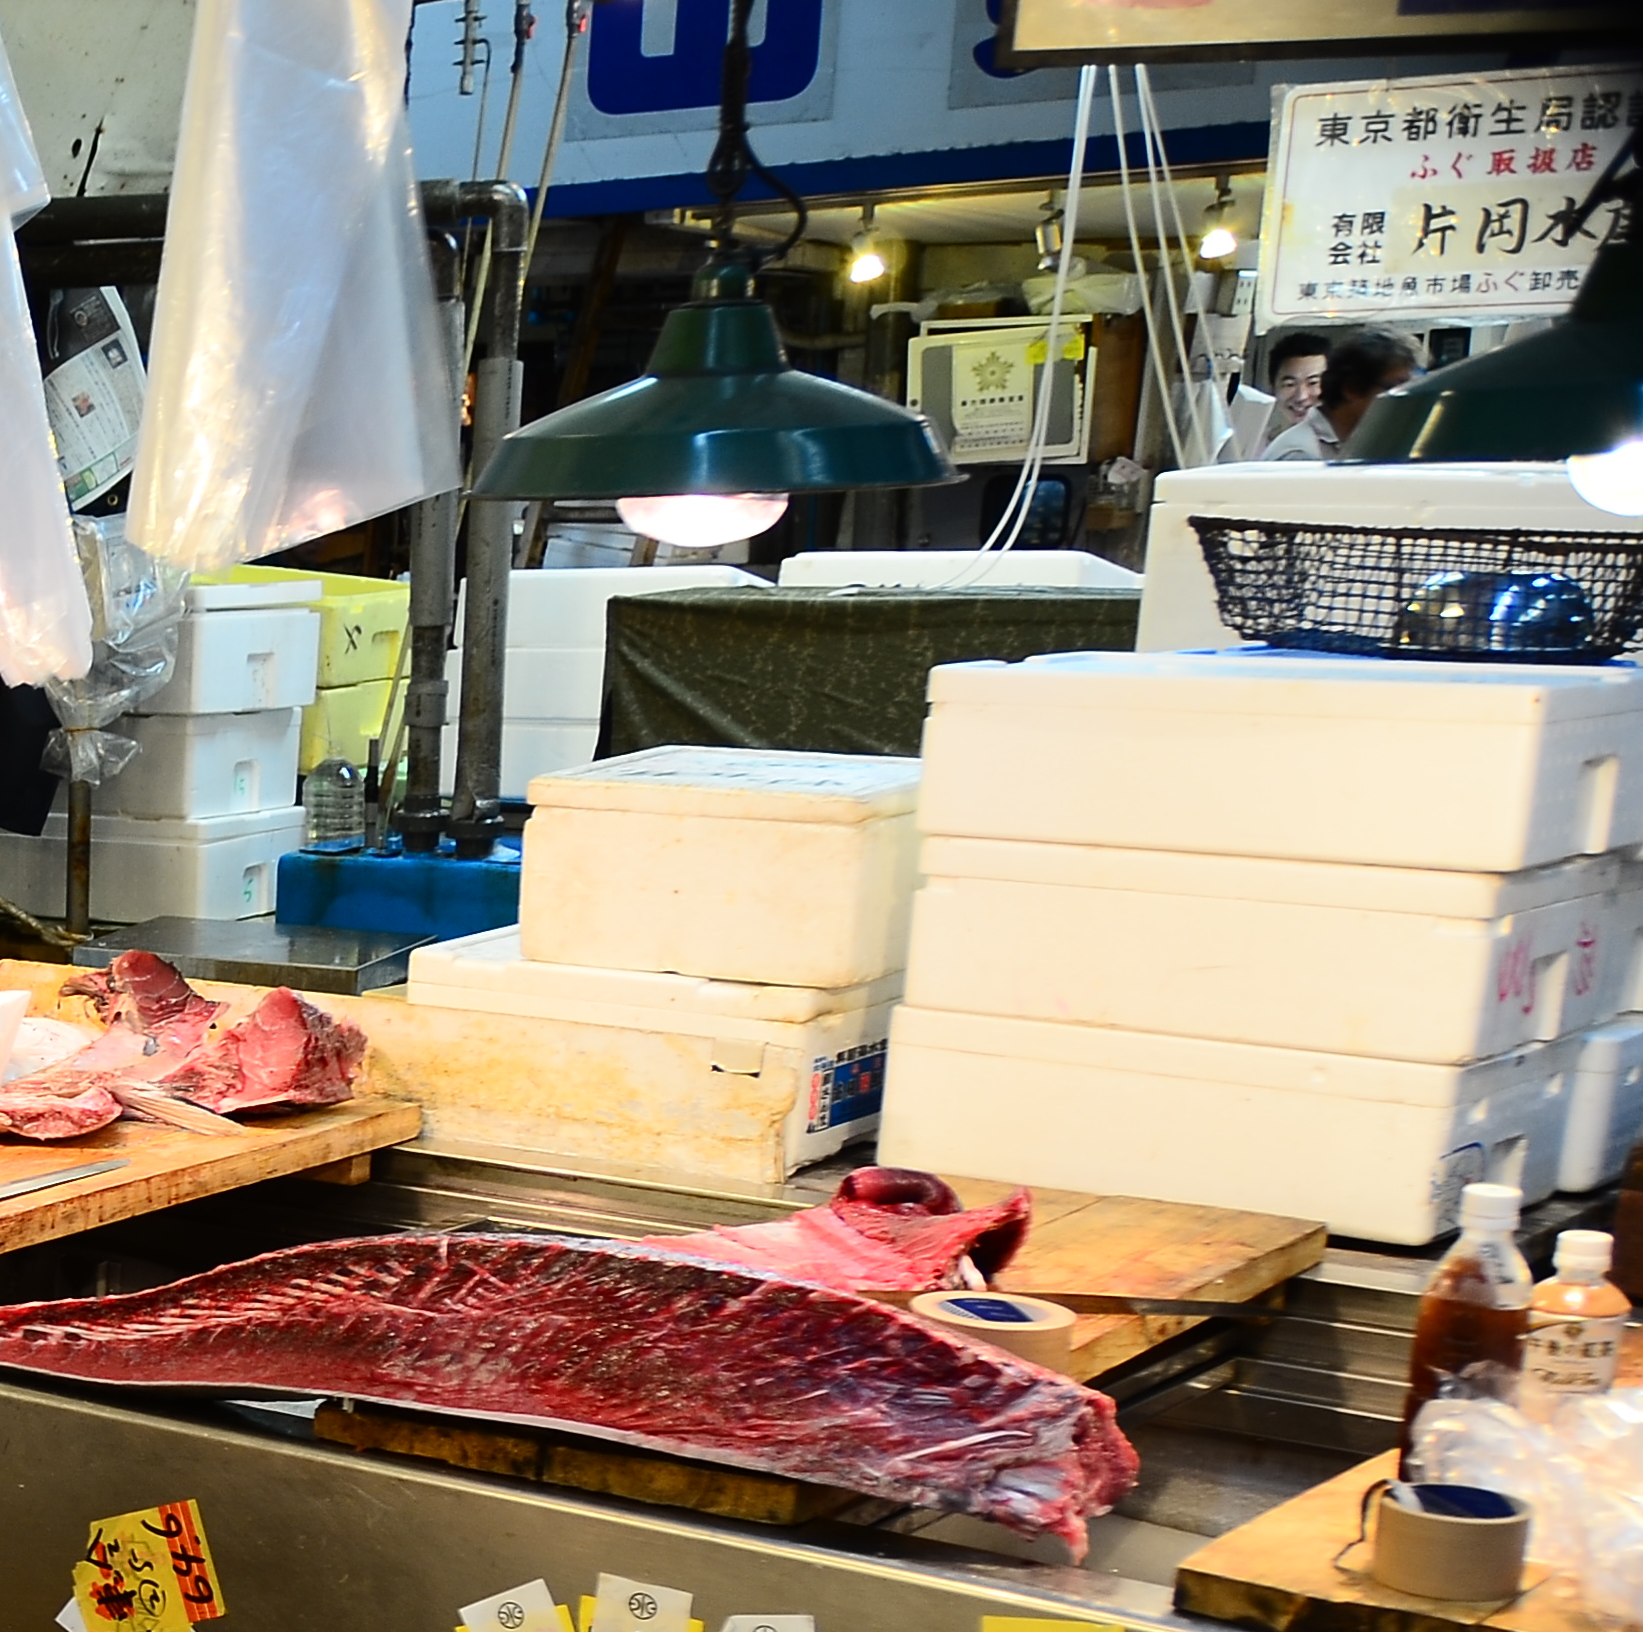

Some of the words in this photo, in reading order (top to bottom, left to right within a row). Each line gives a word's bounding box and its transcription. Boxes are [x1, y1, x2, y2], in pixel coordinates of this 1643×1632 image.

[1410, 141, 1599, 180] ふぐ取扱店
[1330, 210, 1386, 238] 有限
[1328, 240, 1383, 266] 会社
